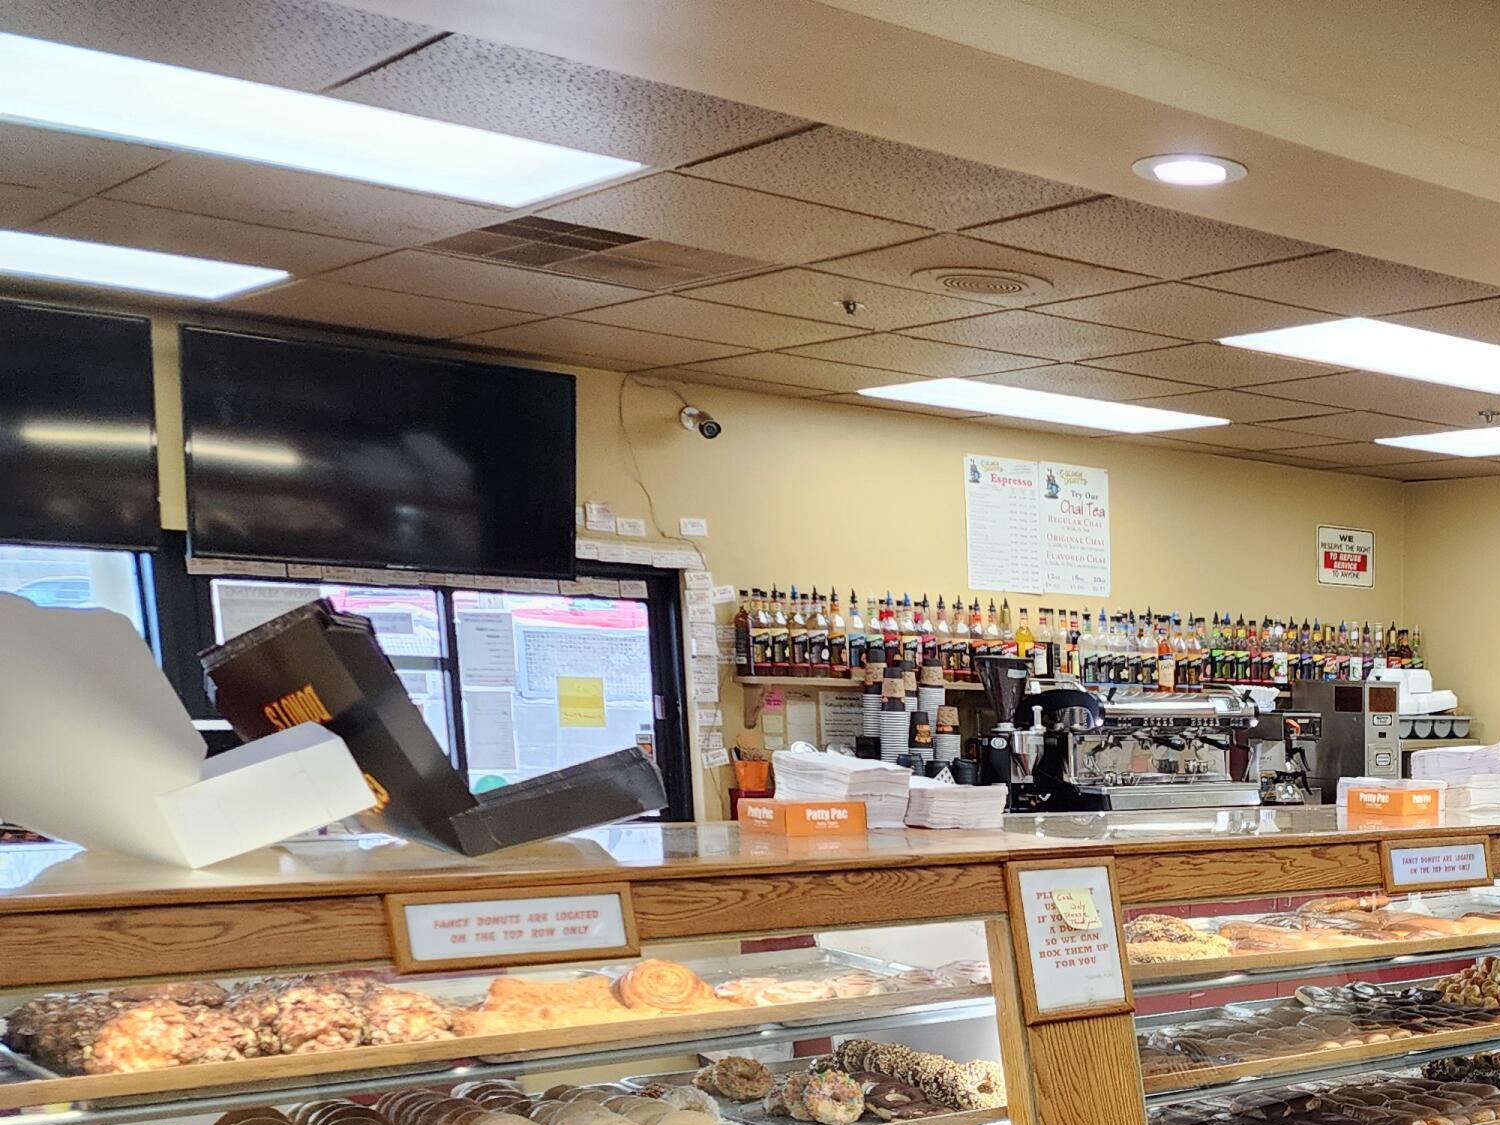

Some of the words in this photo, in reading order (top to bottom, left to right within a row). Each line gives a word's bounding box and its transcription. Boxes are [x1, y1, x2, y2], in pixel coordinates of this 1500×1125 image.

[991, 474, 1033, 487] Espresso
[1071, 490, 1083, 500] Try
[1085, 491, 1099, 500] Our
[1060, 499, 1084, 515] Chai
[1088, 503, 1106, 518] Tea
[1048, 515, 1082, 526] REGULAR
[1083, 519, 1103, 529] CHAI
[1046, 533, 1084, 545] ORIGINAL
[1085, 537, 1105, 546] CHAI
[1339, 535, 1354, 543] WE
[1321, 542, 1343, 551] RESERVE
[1357, 545, 1371, 554] RIGHT
[1046, 551, 1085, 562] FLAVORED
[1086, 555, 1106, 564] CHAI
[1330, 552, 1338, 560] TO
[1340, 553, 1362, 563] REFUSE
[1333, 561, 1358, 571] SERVICE
[1333, 570, 1339, 578] TO
[1341, 571, 1360, 579] ANYONE
[805, 808, 830, 821] Patty
[830, 807, 849, 821] Pac
[1402, 857, 1418, 865] FANCY
[1420, 856, 1441, 864] DONUTS
[1455, 853, 1476, 861] LOCATED
[1420, 866, 1430, 874] THE
[1444, 864, 1456, 873] ROW
[433, 918, 469, 929] FANCY
[477, 915, 521, 926] DONUTS
[527, 912, 548, 923] ARE
[555, 910, 599, 921] LOCATED
[1037, 916, 1047, 924] IF
[1050, 914, 1062, 922] YO
[451, 934, 466, 944] ON
[475, 932, 495, 942] THE
[504, 930, 523, 940] TOP
[531, 928, 555, 938] ROW
[563, 925, 588, 936] ONLY
[1049, 926, 1056, 934] A
[1062, 936, 1075, 944] WE
[1081, 933, 1100, 941] CAN
[1039, 949, 1061, 958] BOX
[1065, 946, 1093, 955] THEM
[1097, 943, 1109, 952] UP
[1055, 960, 1075, 969] FOR
[1078, 957, 1097, 965] YOU
